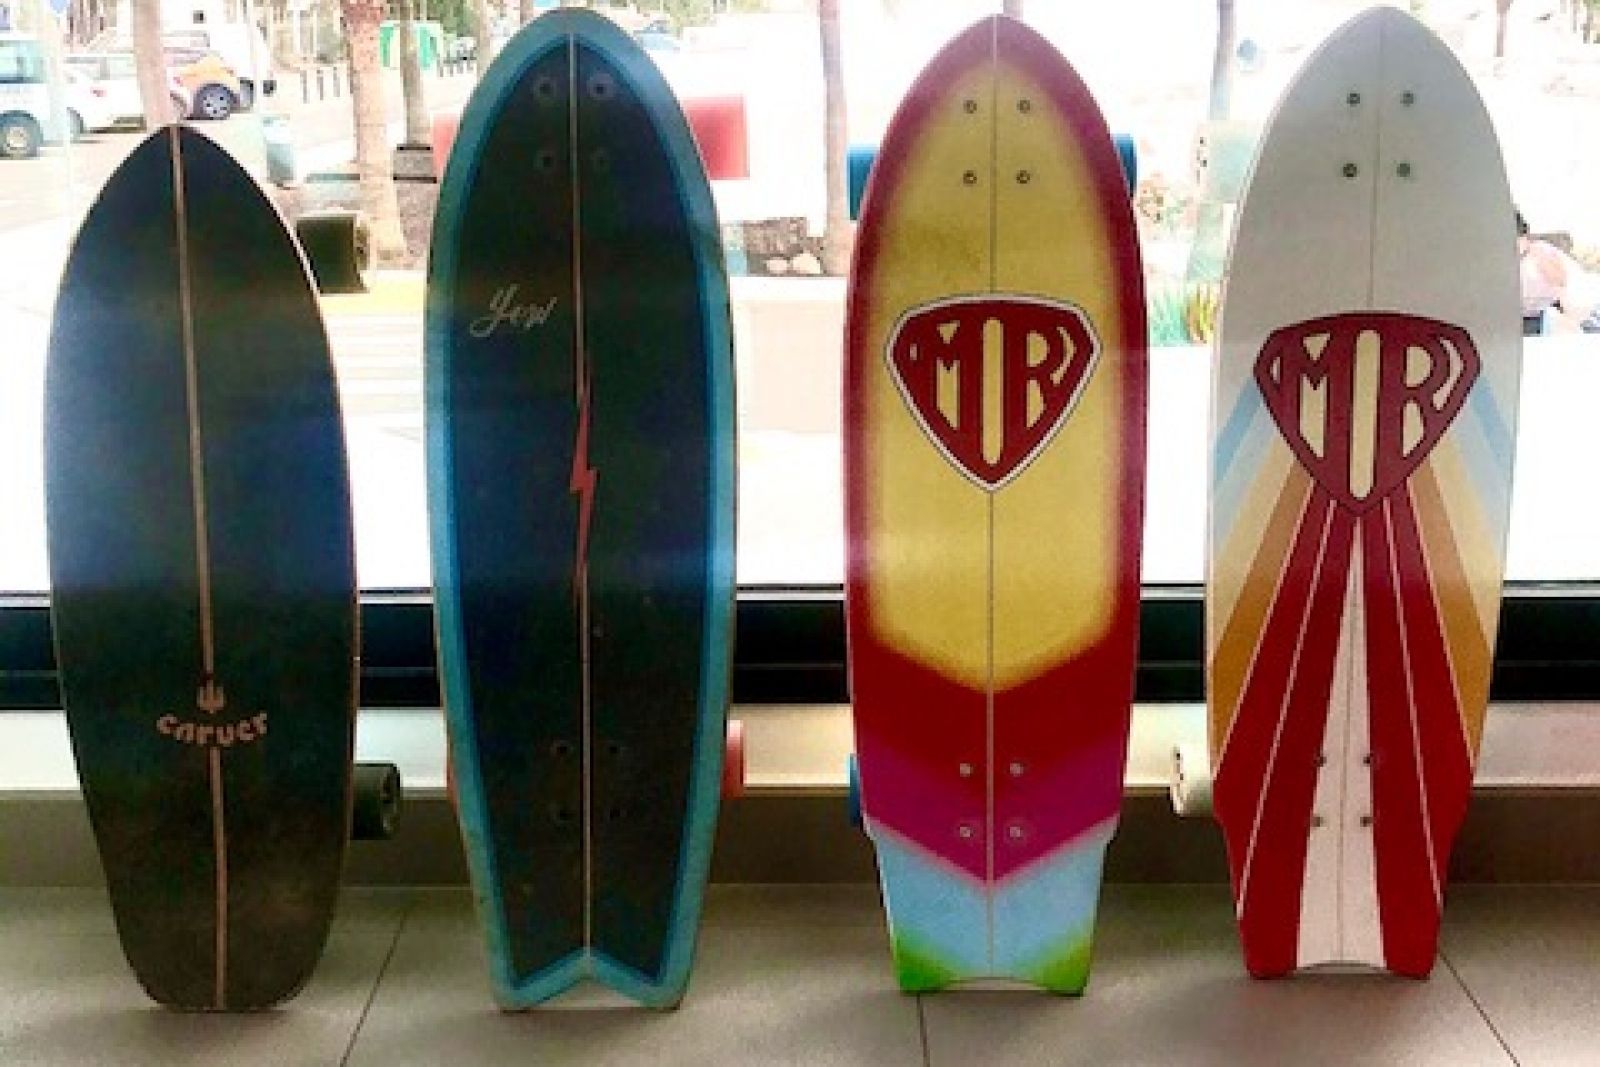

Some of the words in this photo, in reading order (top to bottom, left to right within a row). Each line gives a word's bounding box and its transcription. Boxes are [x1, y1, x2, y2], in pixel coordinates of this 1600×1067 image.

[470, 283, 557, 337] Yow
[893, 302, 1092, 484] MR
[1254, 313, 1480, 511] MR
